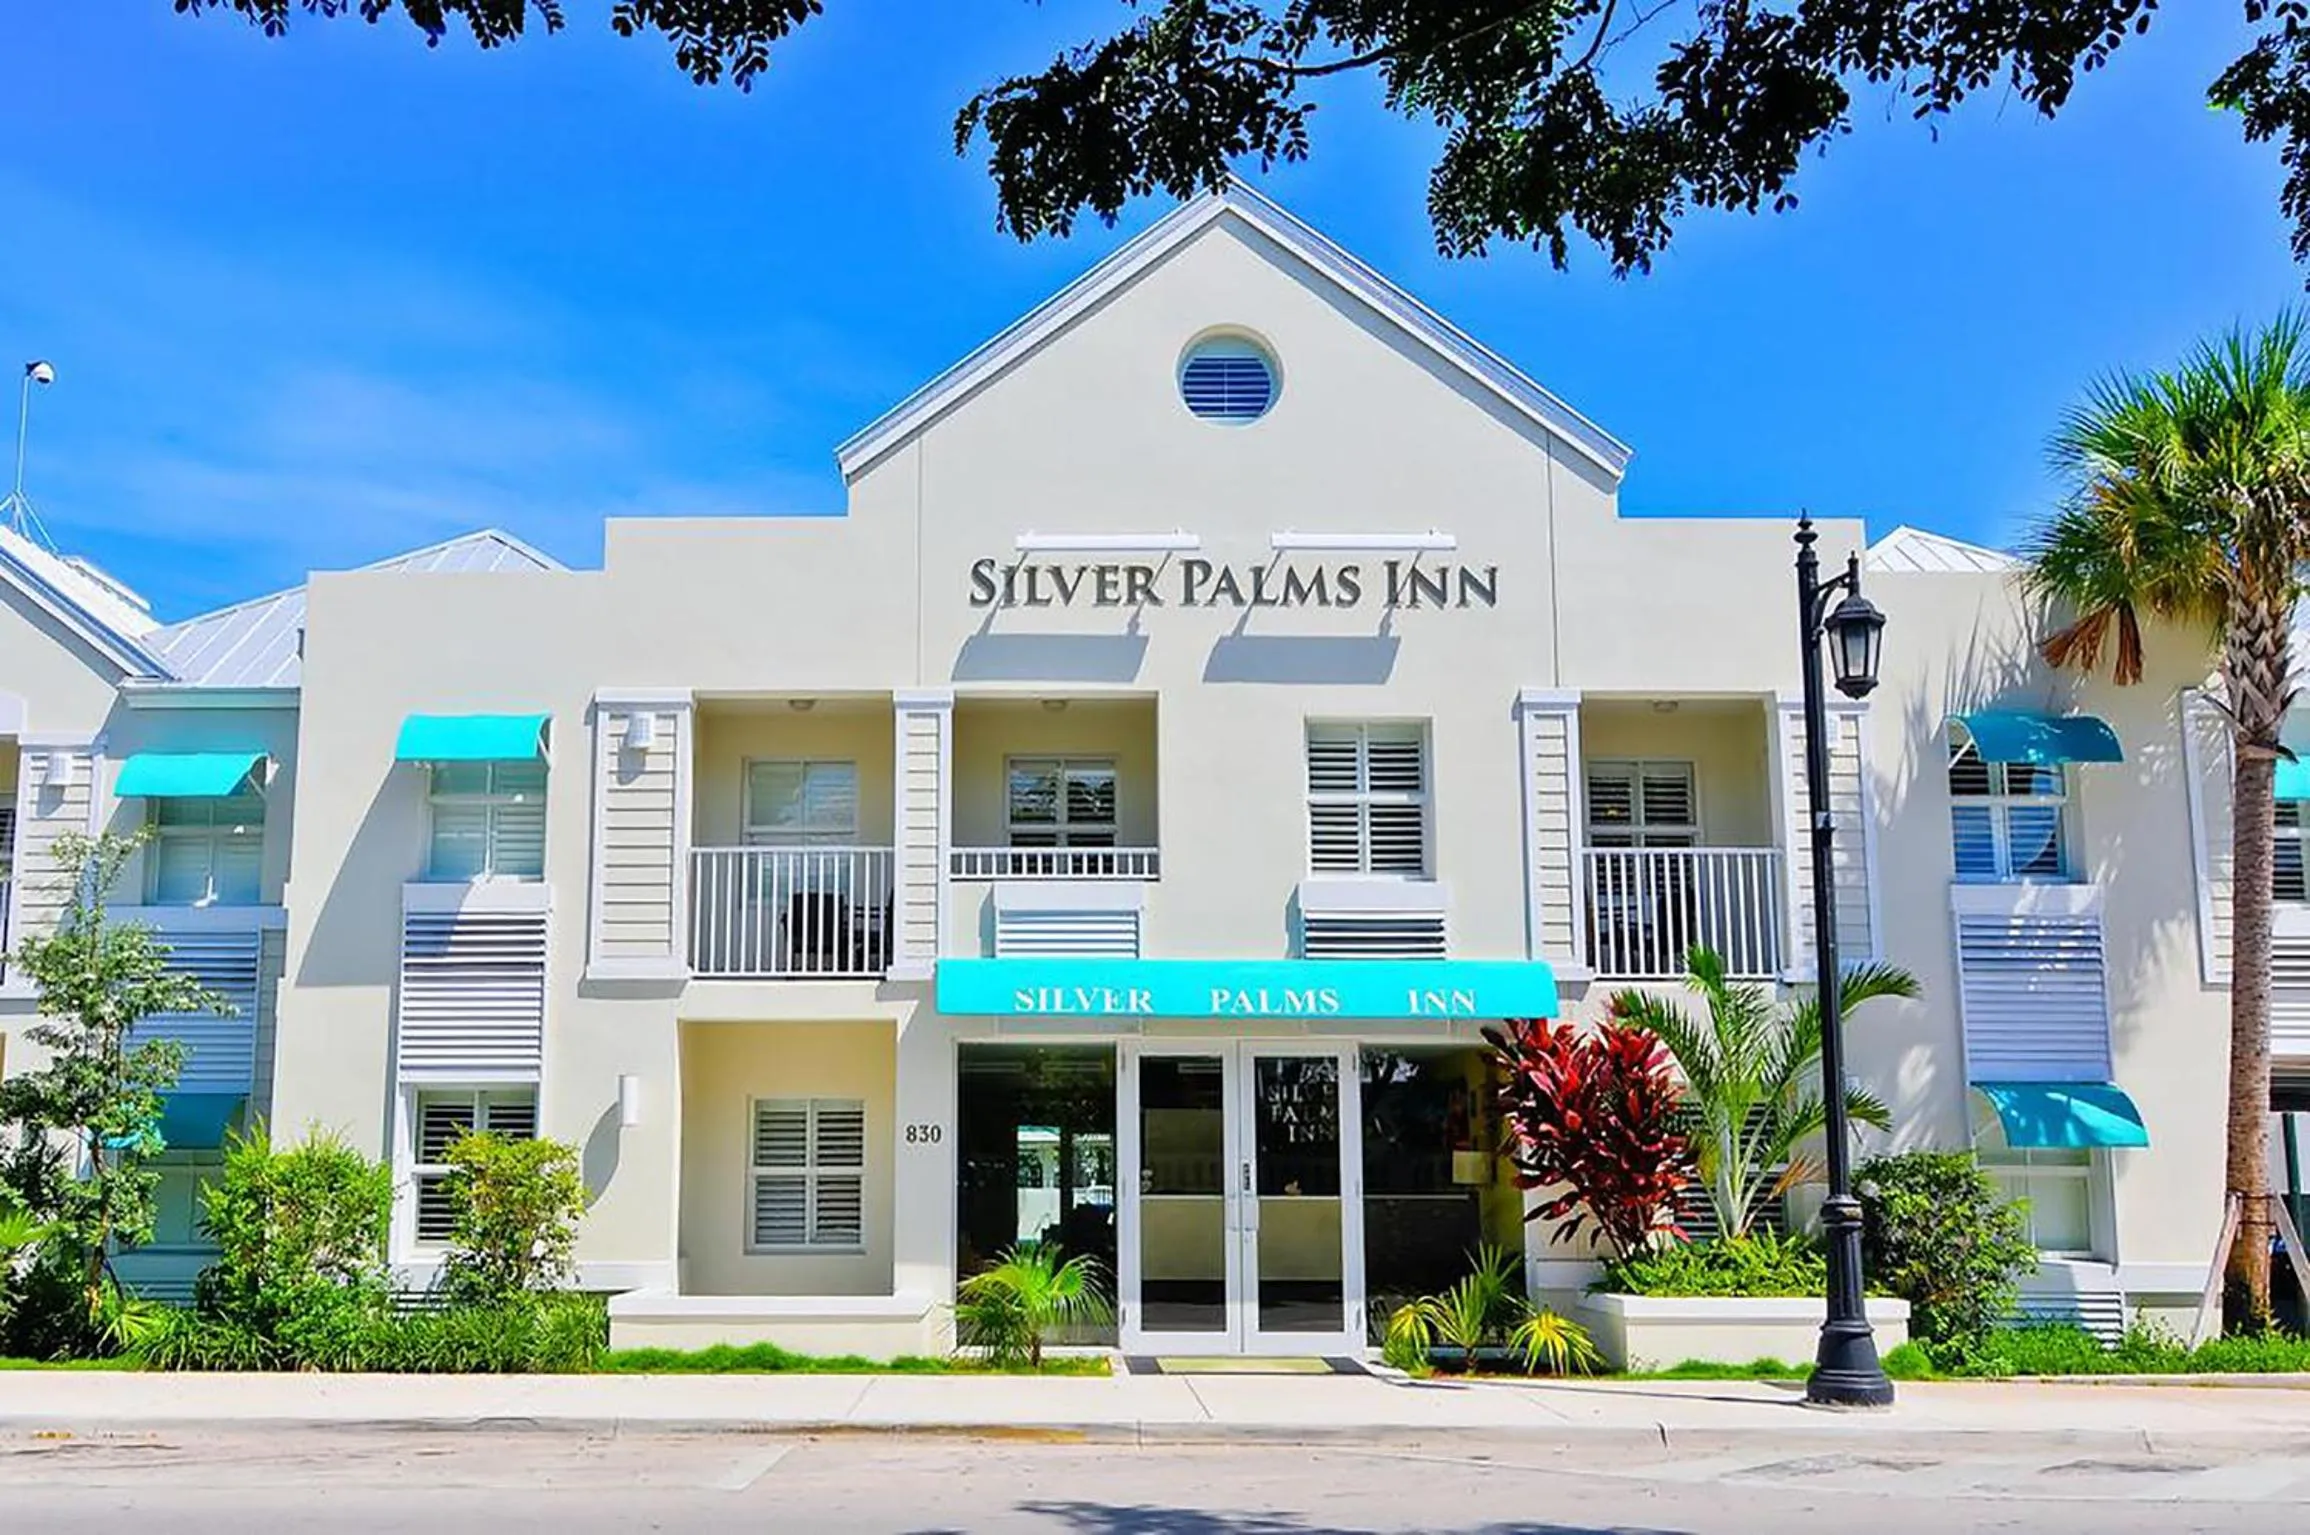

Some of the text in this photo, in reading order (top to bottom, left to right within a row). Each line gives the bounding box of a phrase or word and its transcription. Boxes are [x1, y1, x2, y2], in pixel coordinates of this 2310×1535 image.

[970, 558, 1497, 609] SILVER PALMS INN
[1014, 987, 1476, 1015] SILVER PALMS INN
[906, 1124, 941, 1144] 830
